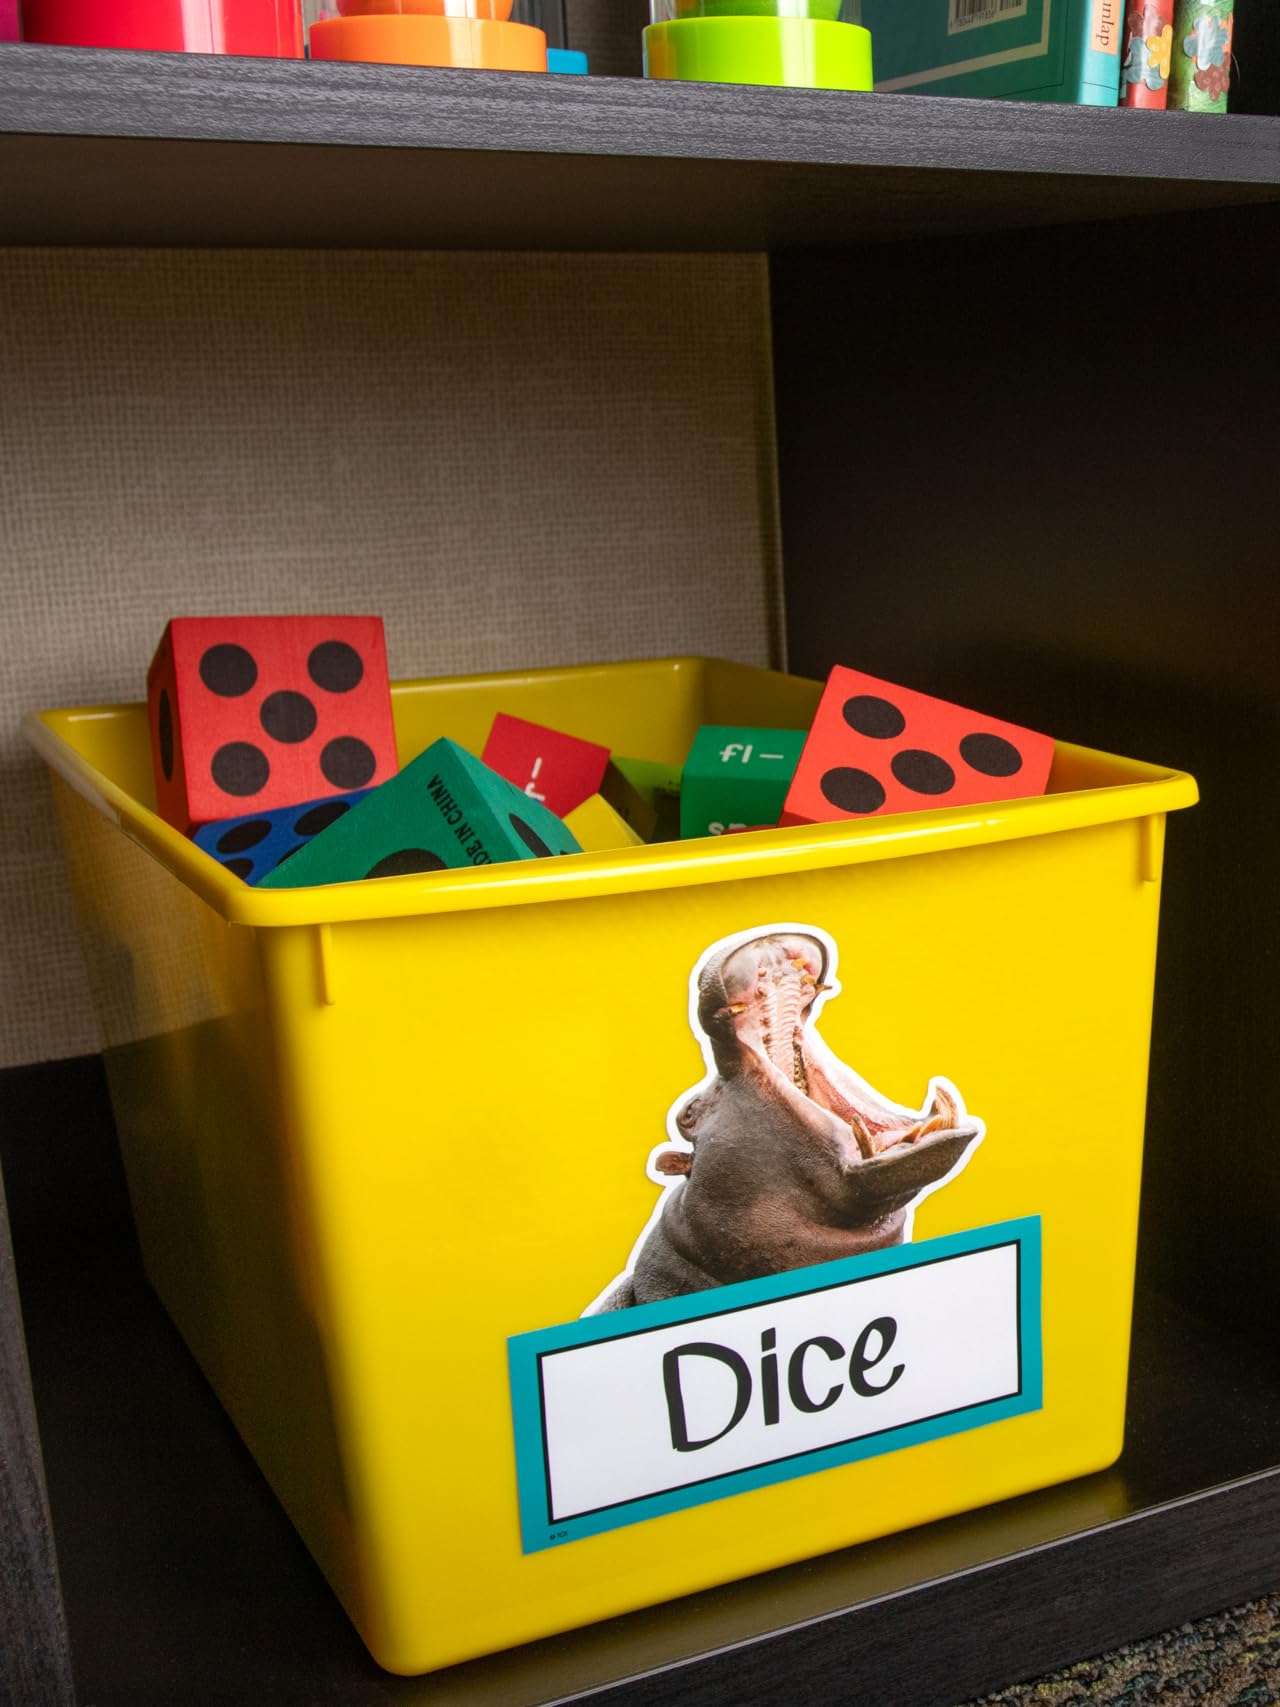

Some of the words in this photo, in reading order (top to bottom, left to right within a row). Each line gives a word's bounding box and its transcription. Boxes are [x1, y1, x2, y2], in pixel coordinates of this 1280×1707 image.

[426, 773, 464, 826] CHINA
[454, 821, 476, 846] IN
[662, 1315, 906, 1453] Dice
